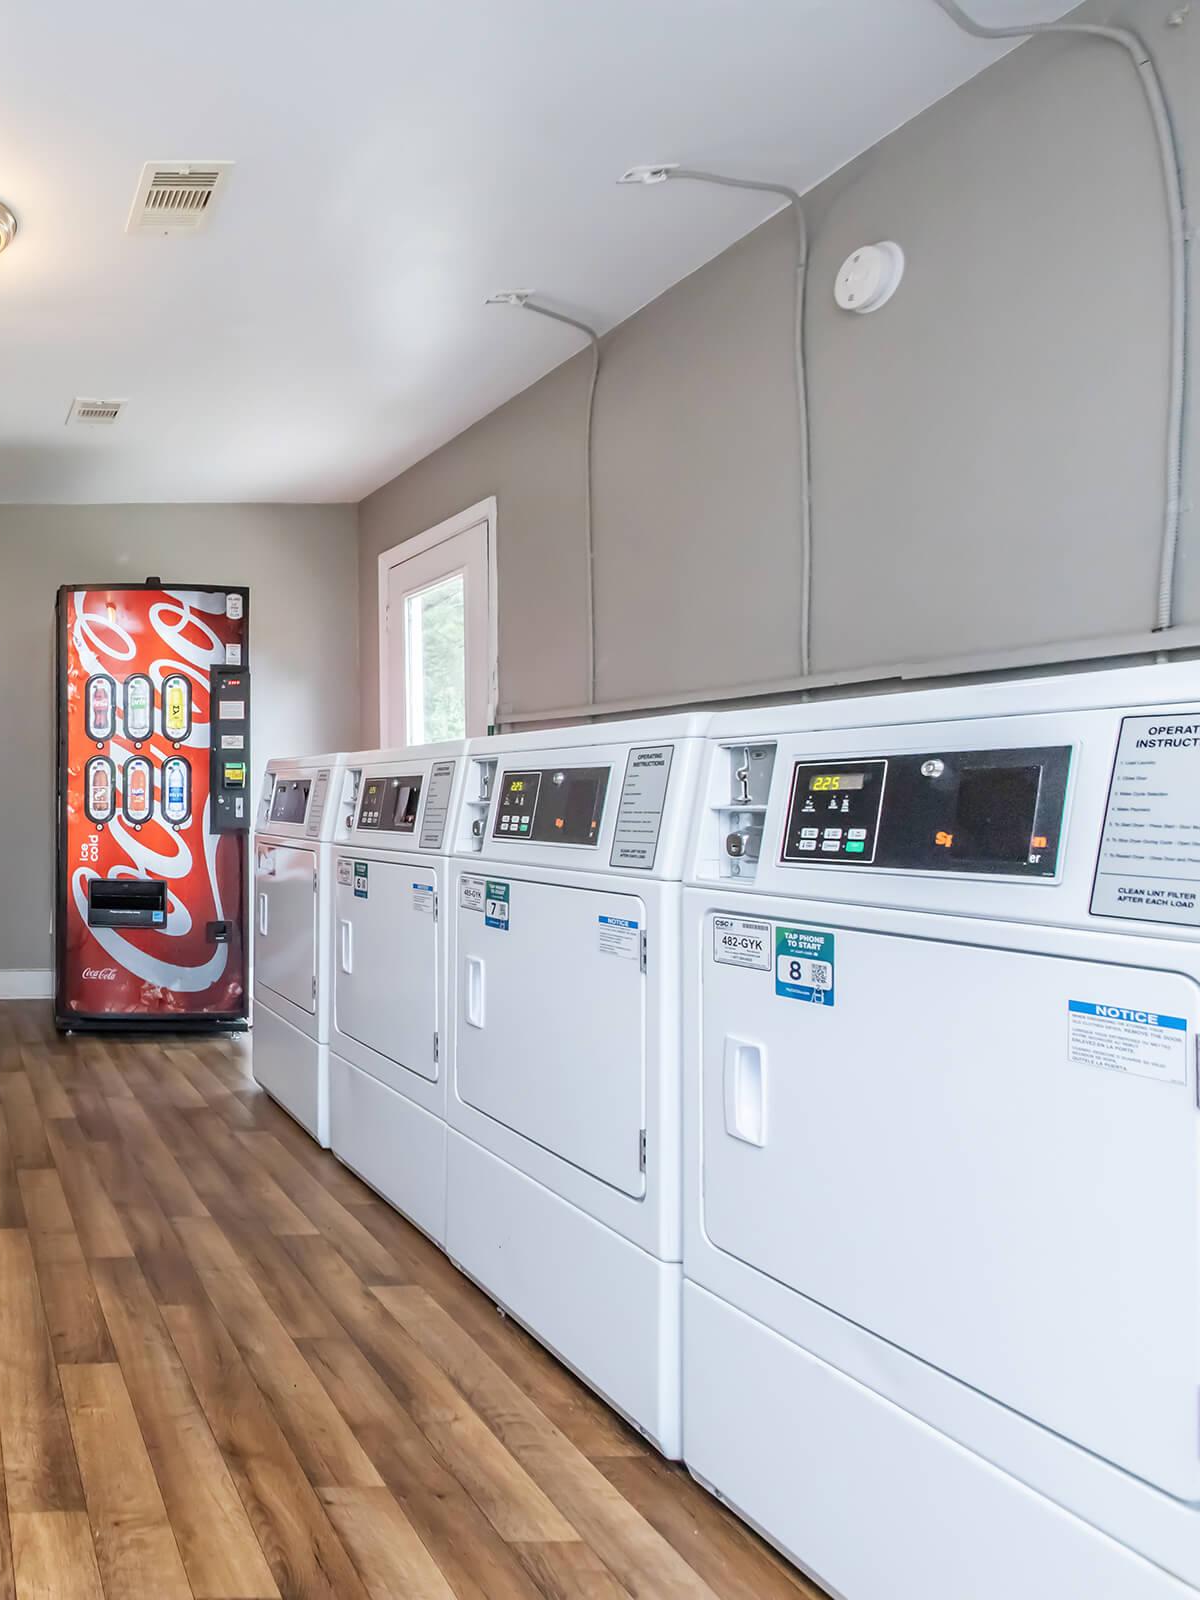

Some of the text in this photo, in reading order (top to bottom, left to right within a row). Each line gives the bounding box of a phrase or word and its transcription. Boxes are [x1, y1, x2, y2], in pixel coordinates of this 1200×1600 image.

[79, 843, 89, 862] Ice
[88, 834, 99, 862] cold
[1118, 887, 1197, 900] CLEAN LINT FILTER
[491, 902, 496, 915] 7
[1117, 895, 1195, 909] AFTER EACH LOAD
[715, 919, 729, 928] CSC
[721, 935, 763, 951] 482-GYK
[784, 932, 825, 945] TAP PHONE
[787, 939, 822, 951] TO START
[789, 960, 802, 981] 8
[1095, 1005, 1159, 1026] NOTICE
